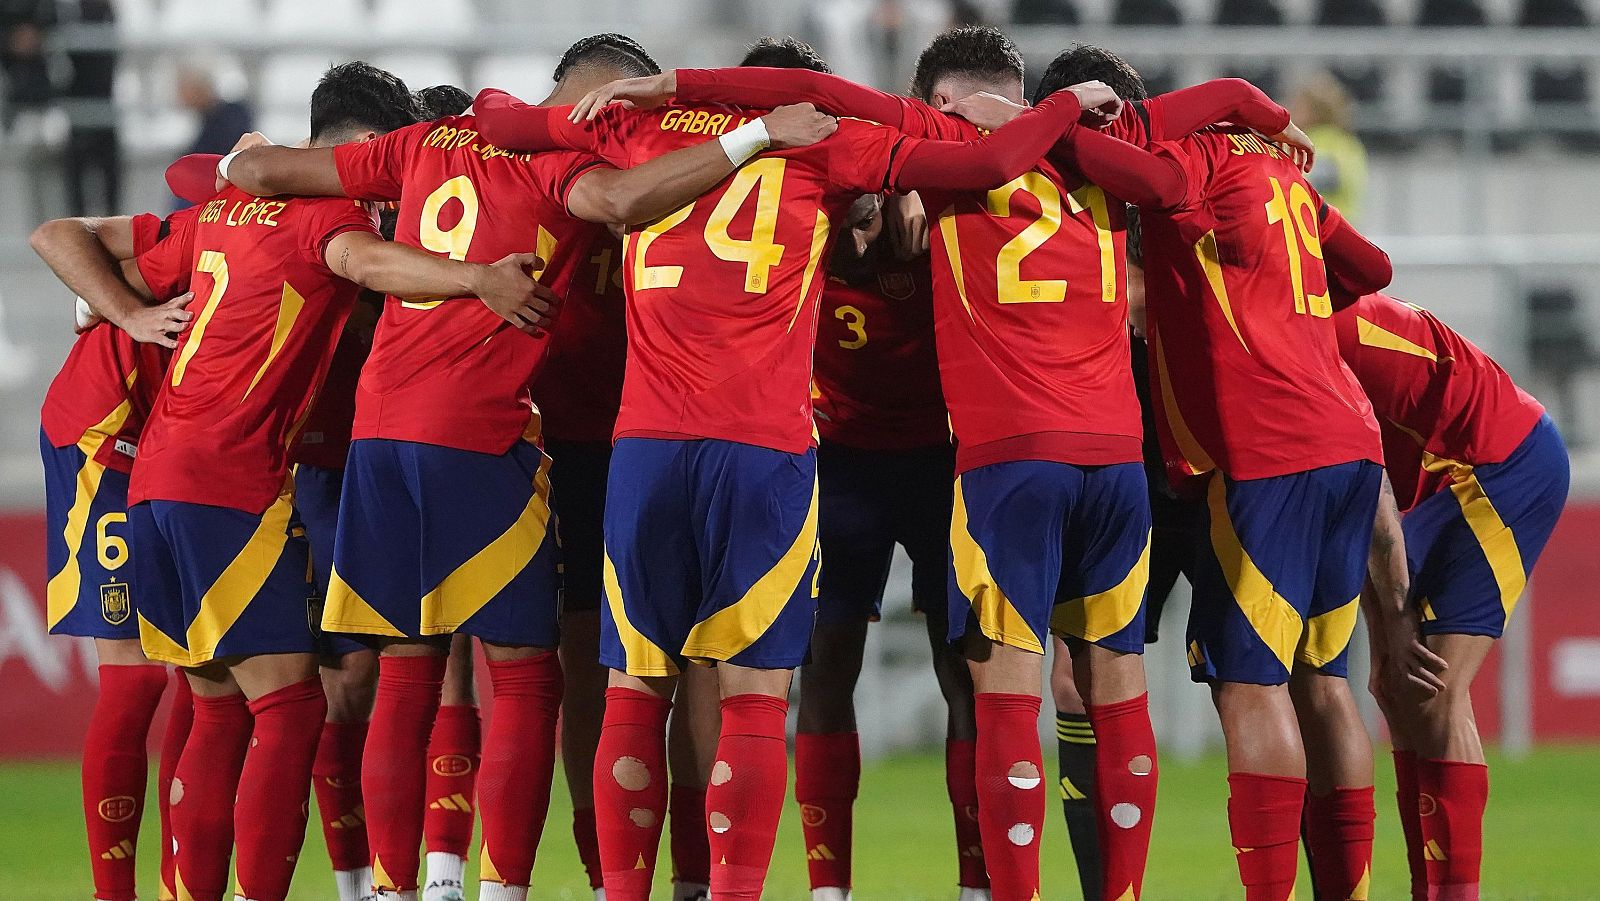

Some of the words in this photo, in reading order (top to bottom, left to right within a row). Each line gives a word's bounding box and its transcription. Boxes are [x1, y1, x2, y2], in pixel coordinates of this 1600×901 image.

[660, 109, 733, 136] GABRI
[226, 197, 287, 227] LÓPEZ
[402, 175, 479, 310] 9
[634, 157, 787, 294] 24
[987, 171, 1117, 304] 21
[1264, 176, 1333, 319] 19
[172, 250, 230, 387] 7
[835, 305, 868, 349] 3
[97, 512, 129, 571] 6
